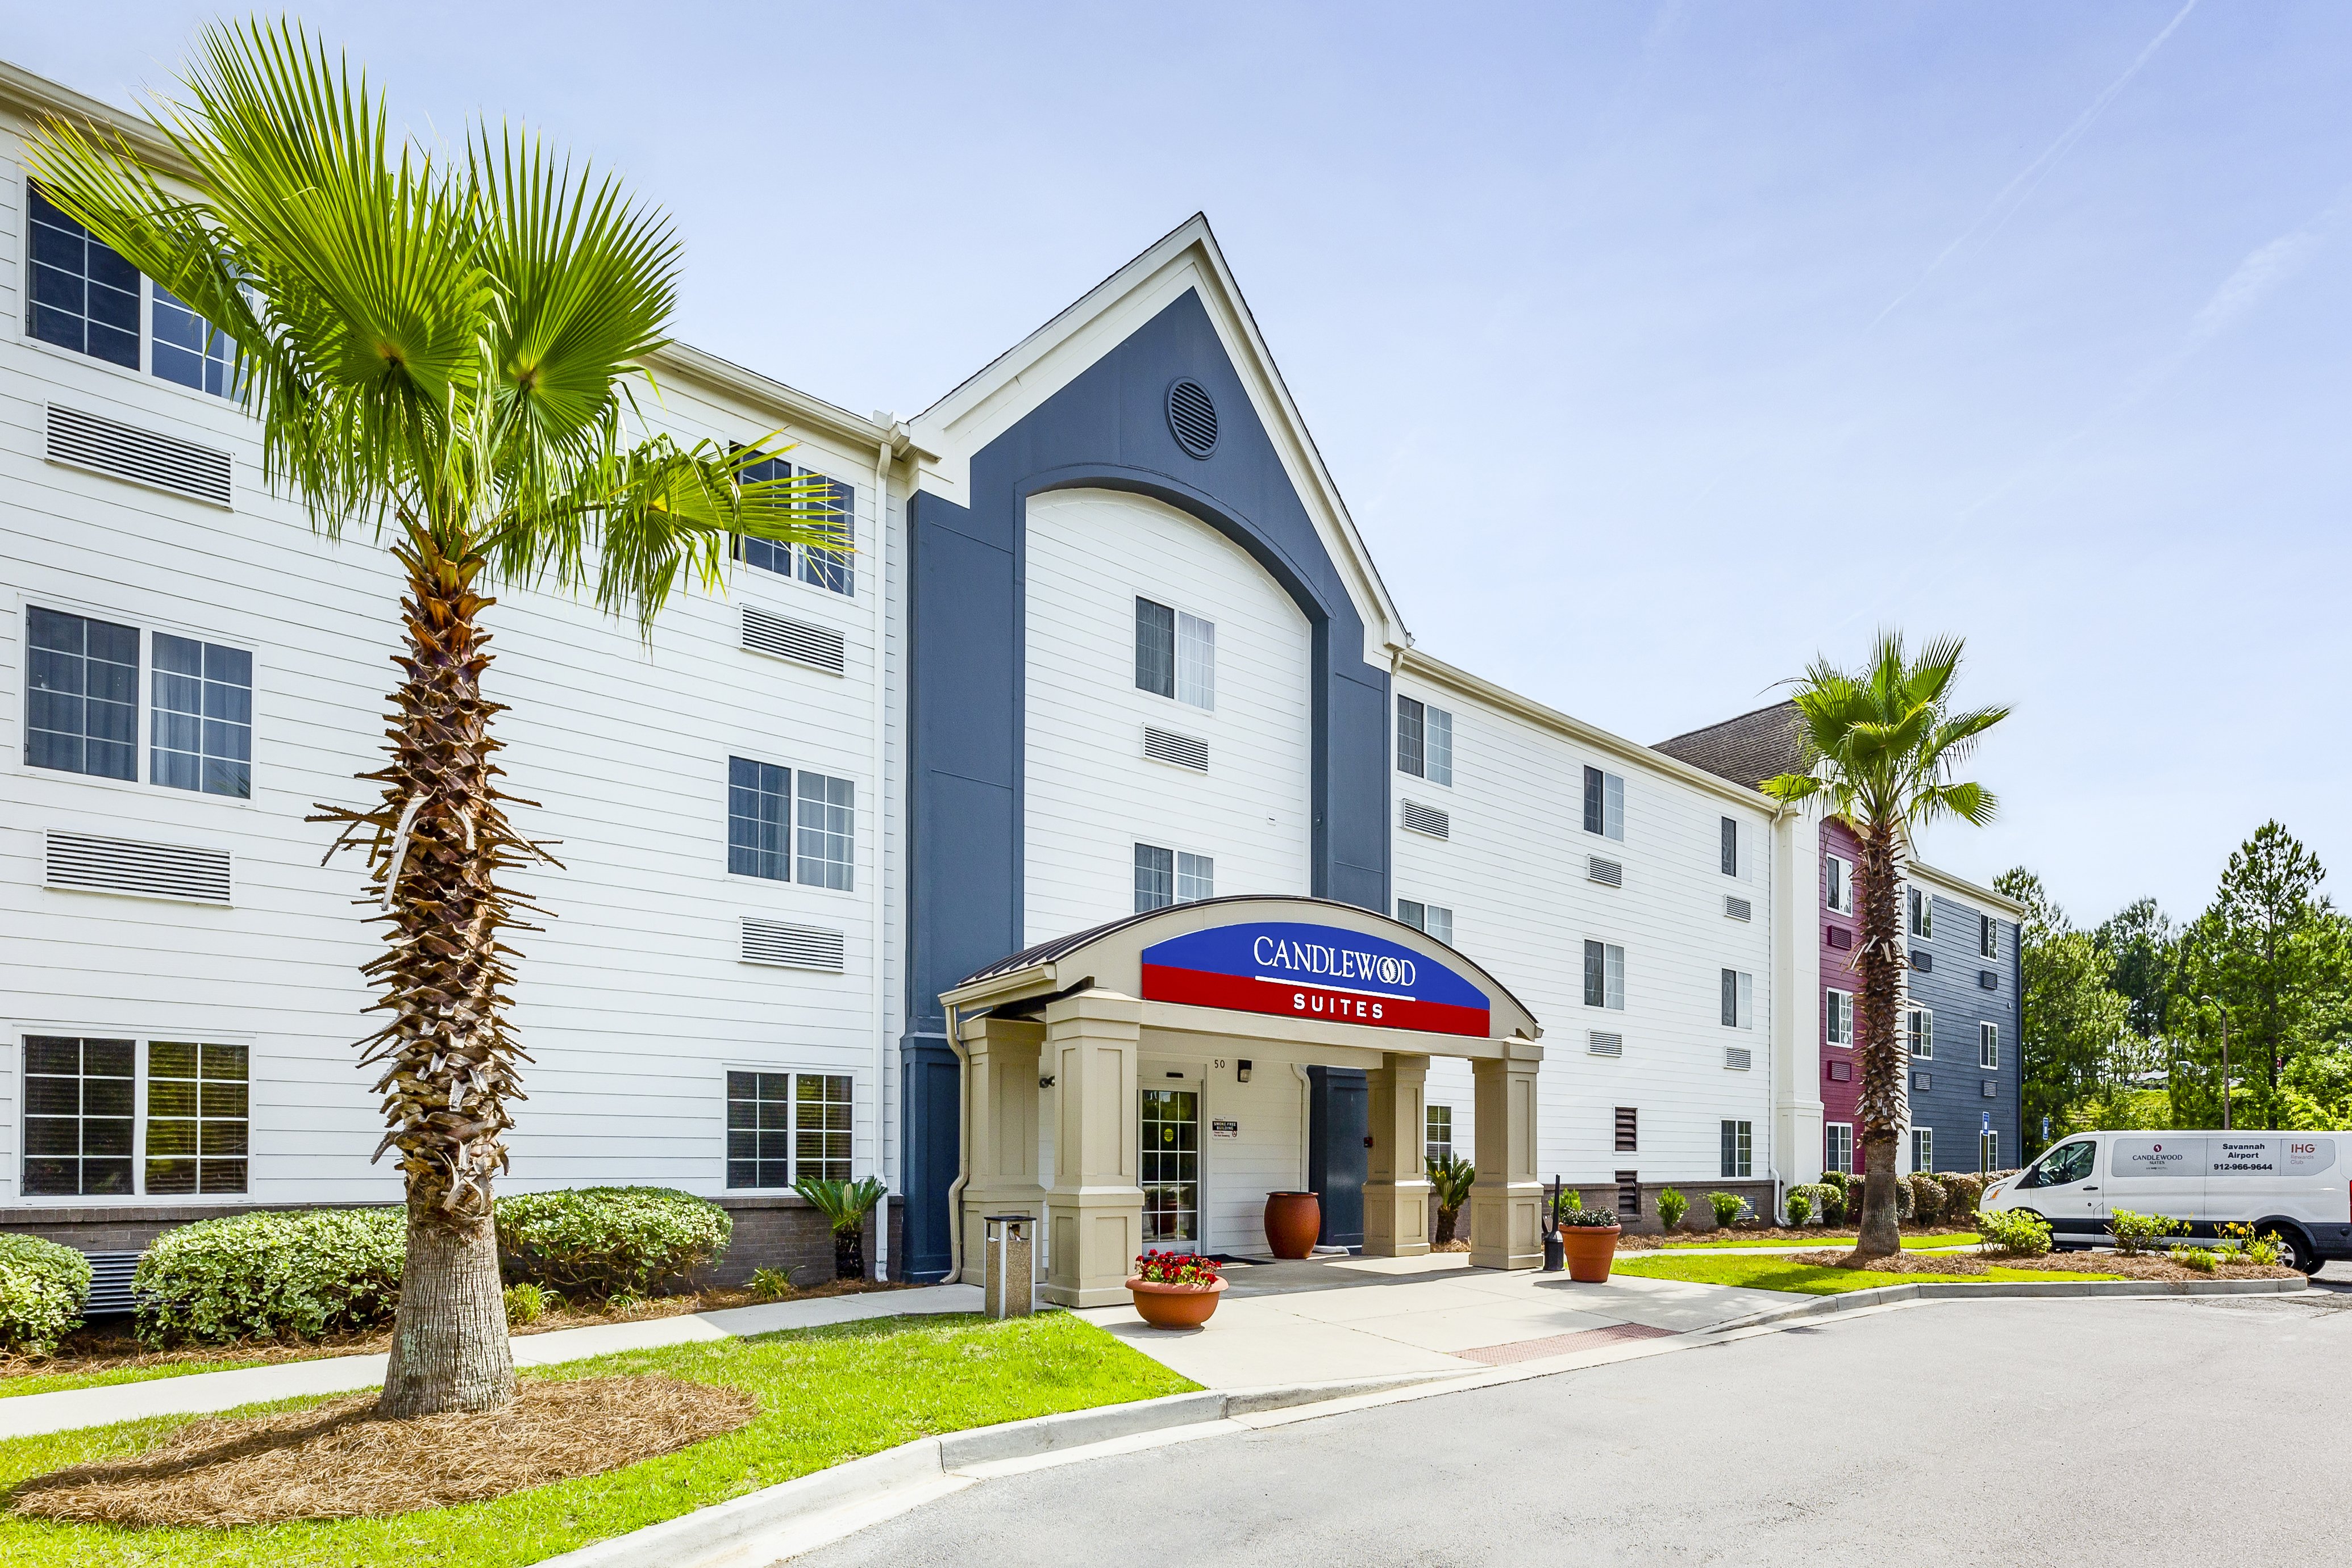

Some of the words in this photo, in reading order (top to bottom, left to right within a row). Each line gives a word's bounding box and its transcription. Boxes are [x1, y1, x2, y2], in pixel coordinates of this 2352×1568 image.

[1254, 936, 1416, 986] CANDLEWOOD
[1293, 993, 1383, 1019] SUITES
[1214, 1059, 1225, 1069] 50
[2291, 1144, 2316, 1153] IHG
